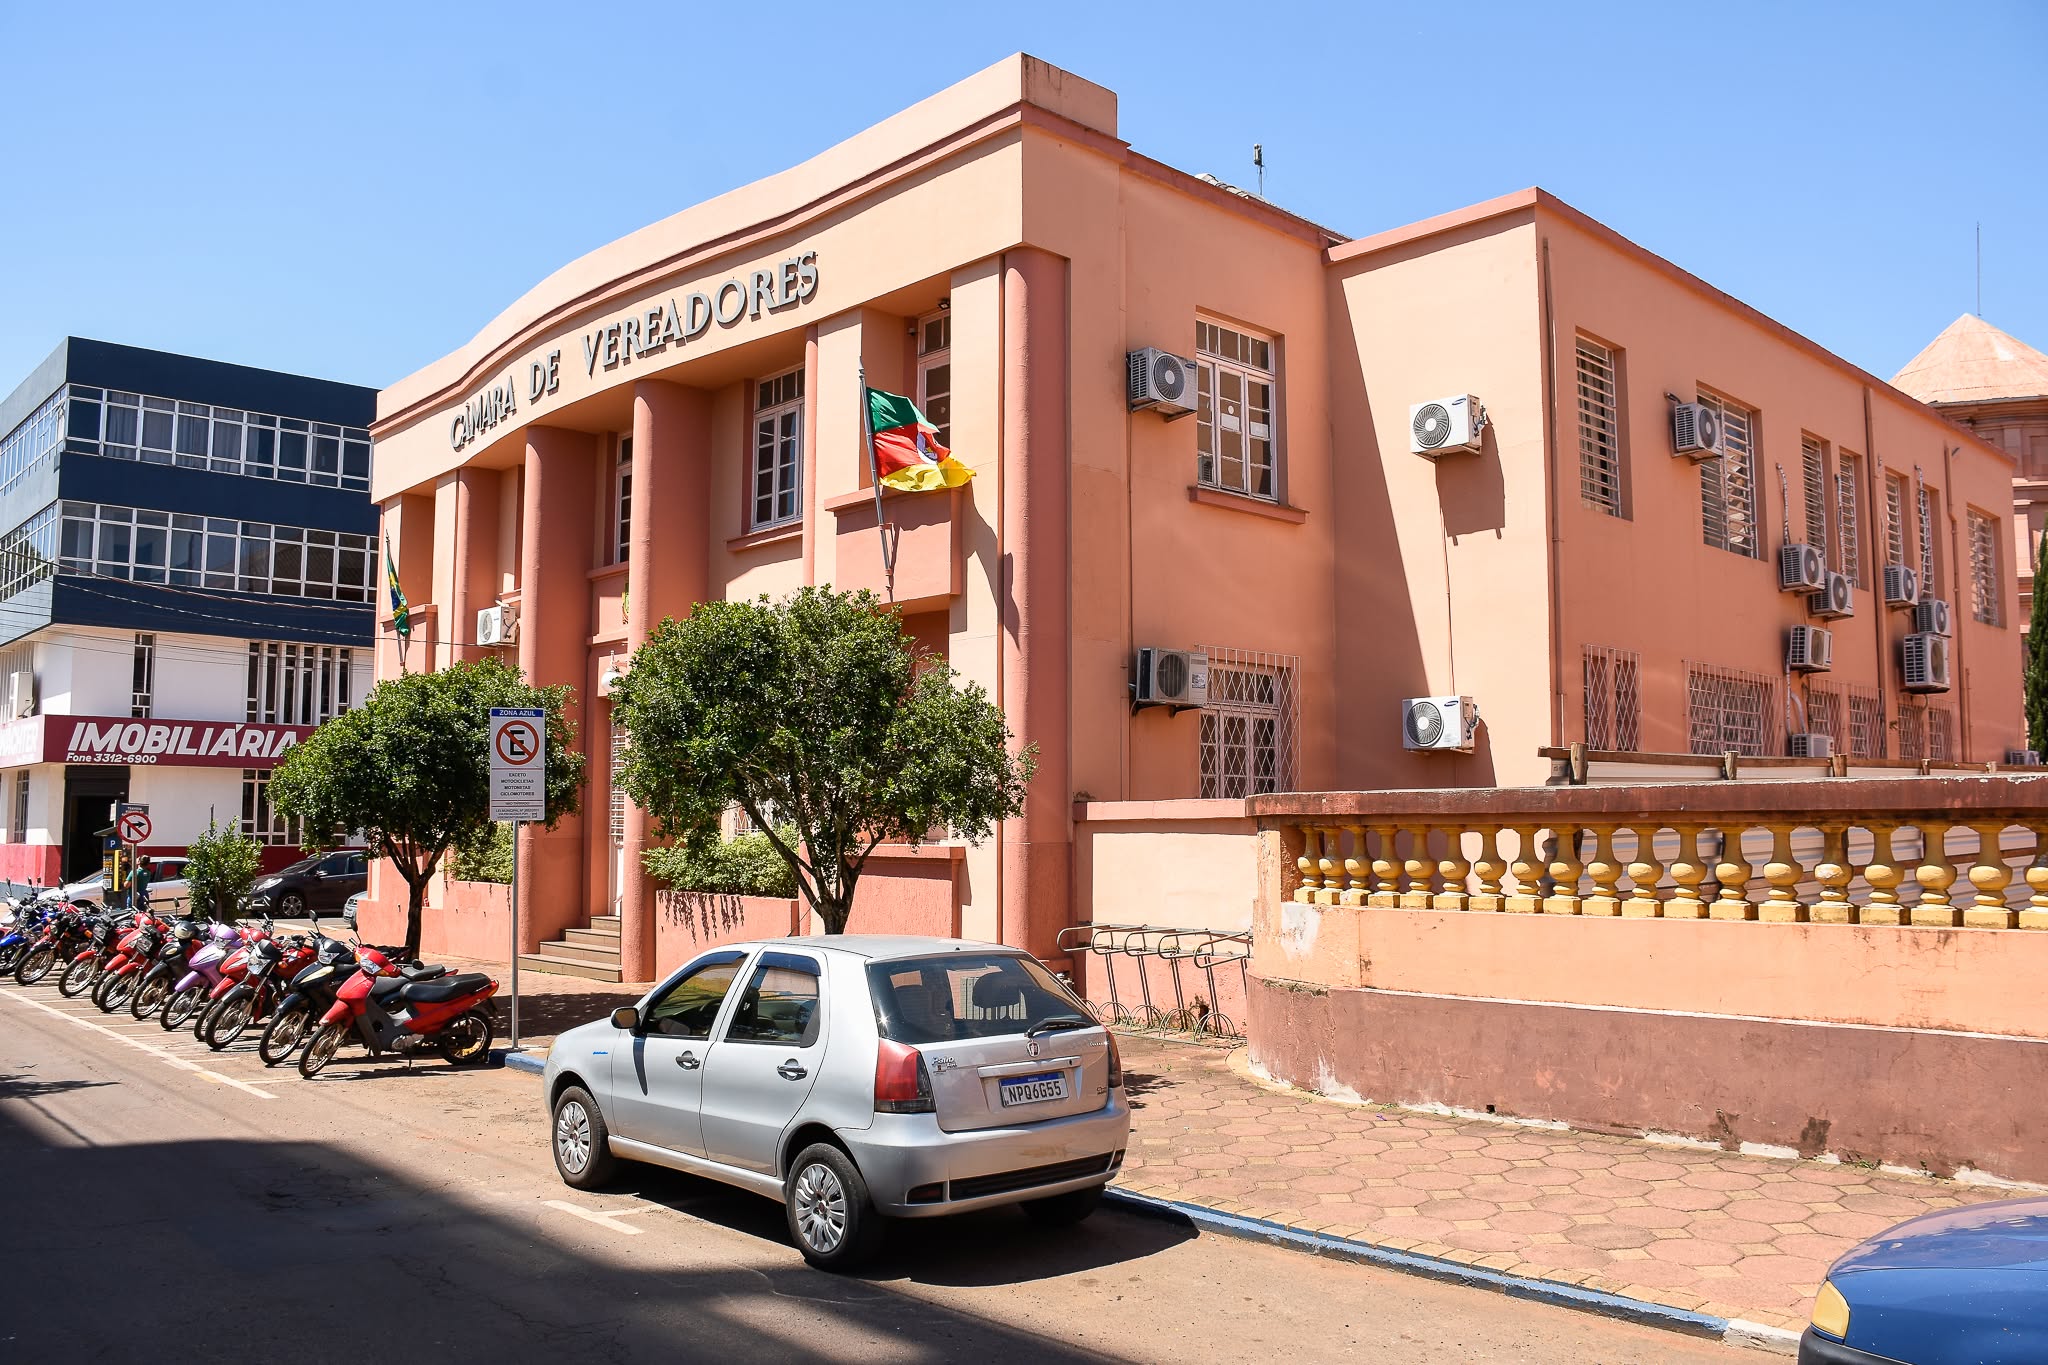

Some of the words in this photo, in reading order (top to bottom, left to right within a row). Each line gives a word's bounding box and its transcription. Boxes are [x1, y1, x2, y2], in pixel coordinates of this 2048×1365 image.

[529, 349, 560, 402] DE
[581, 250, 818, 377] VEREADORES
[499, 709, 518, 717] ZONA
[519, 709, 536, 717] AZUL
[68, 721, 298, 758] IMOBILIÁRIA
[66, 752, 92, 763] Fone
[94, 752, 157, 764] 3312-6900
[109, 839, 117, 848] P
[1008, 1080, 1062, 1103] NPQ6G55
